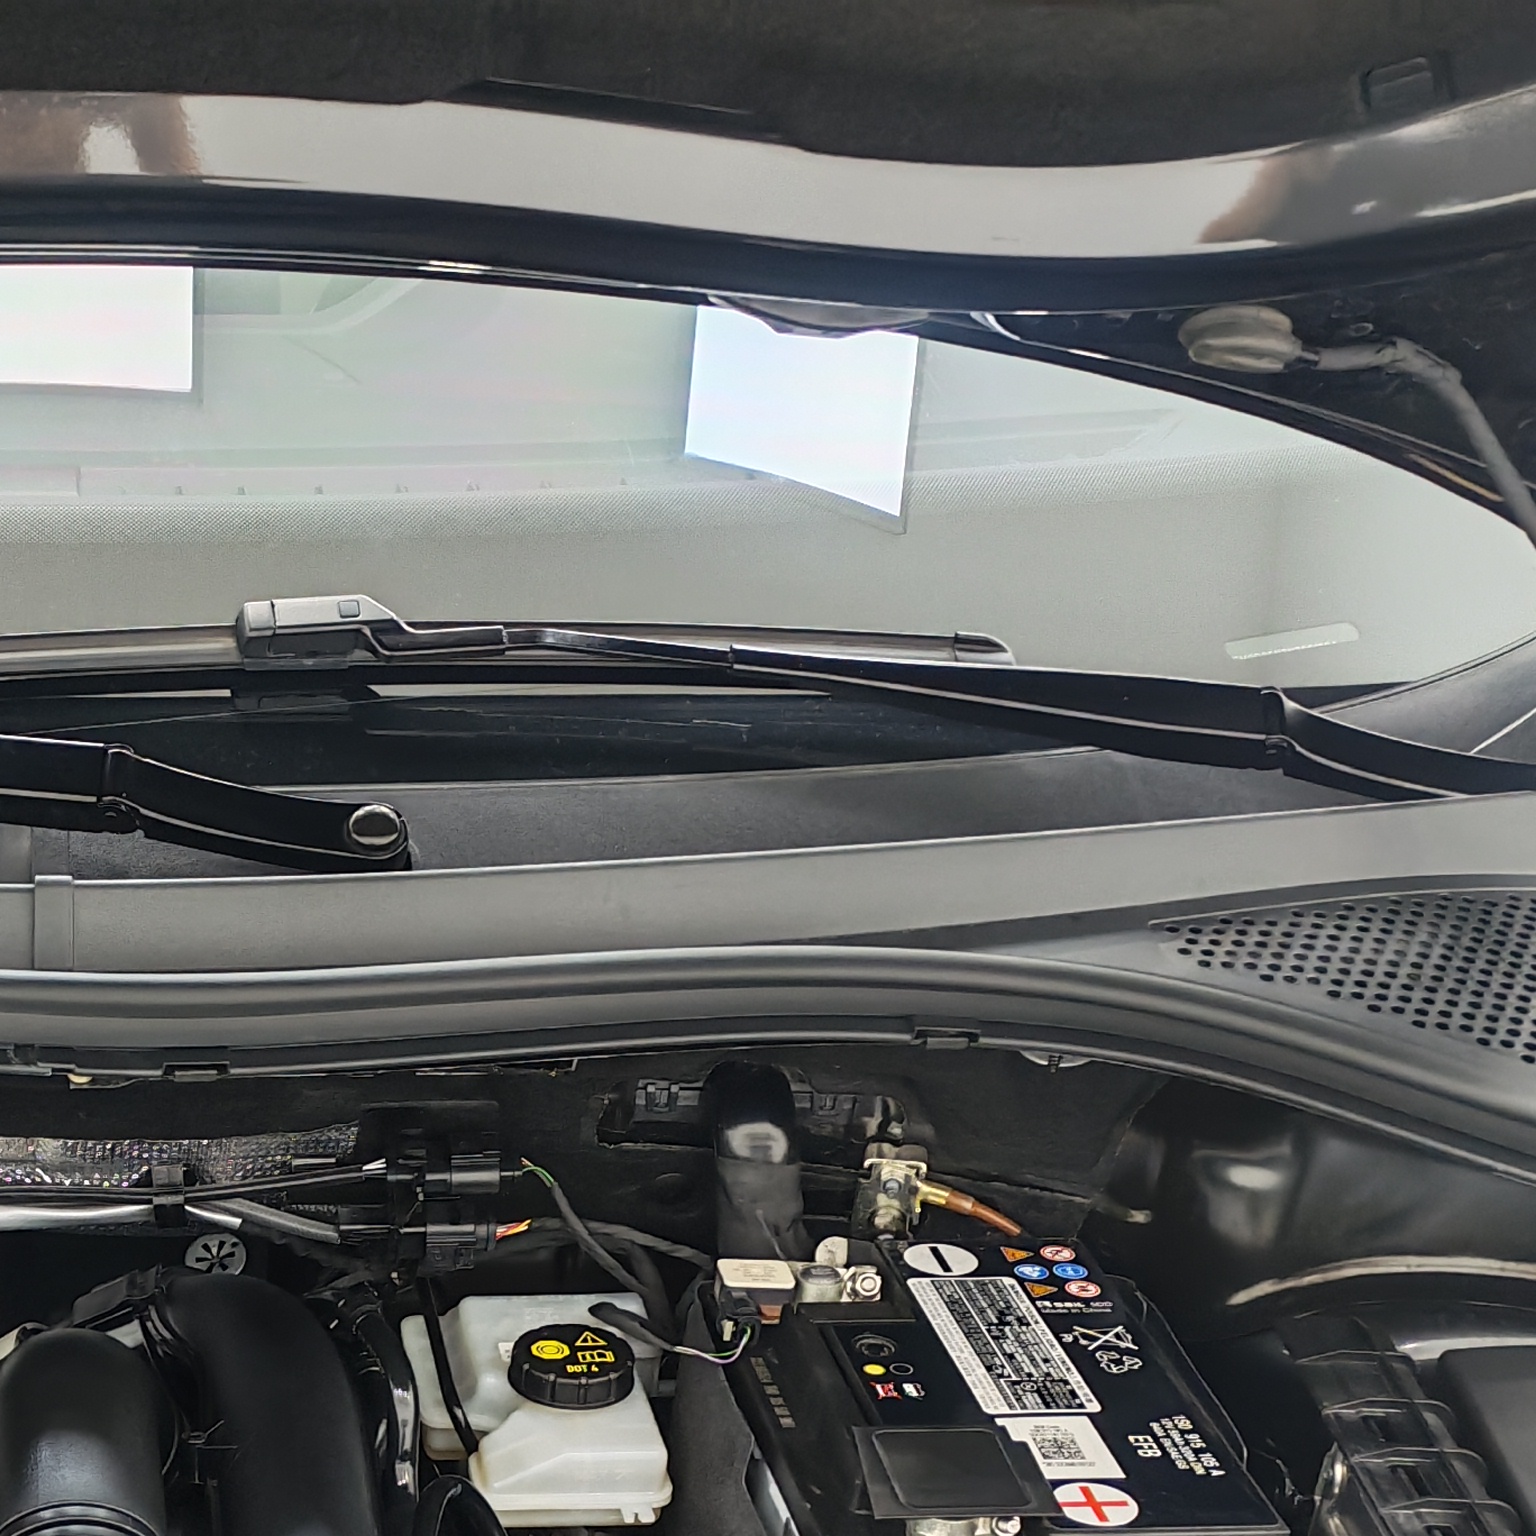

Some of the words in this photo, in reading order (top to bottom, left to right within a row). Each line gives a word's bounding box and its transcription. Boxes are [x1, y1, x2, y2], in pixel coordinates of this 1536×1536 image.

[566, 1364, 588, 1373] DOT
[591, 1364, 600, 1373] 4
[1127, 1435, 1162, 1457] EFB
